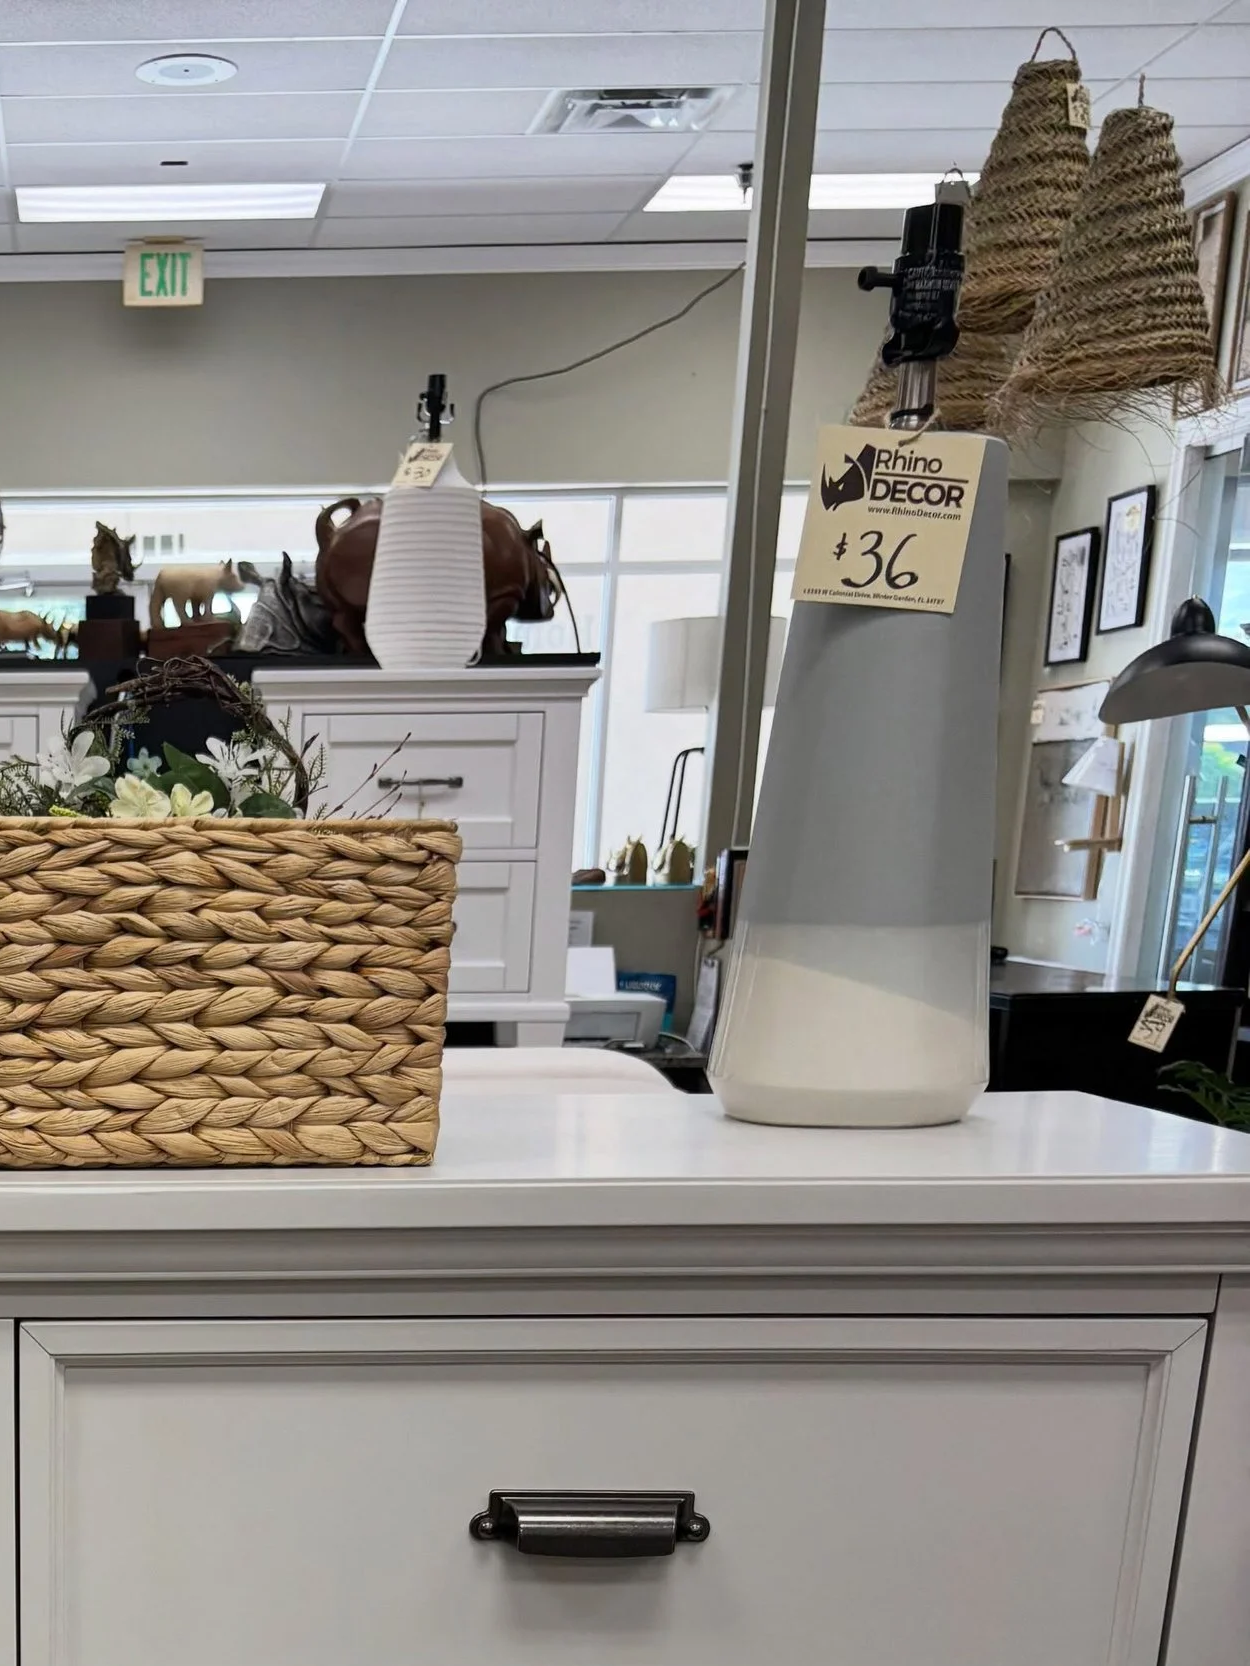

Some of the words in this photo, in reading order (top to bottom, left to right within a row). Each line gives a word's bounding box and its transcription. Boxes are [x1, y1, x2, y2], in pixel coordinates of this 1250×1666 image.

[140, 252, 192, 297] EXIT
[876, 448, 943, 474] Rhino
[870, 478, 966, 509] DECOR
